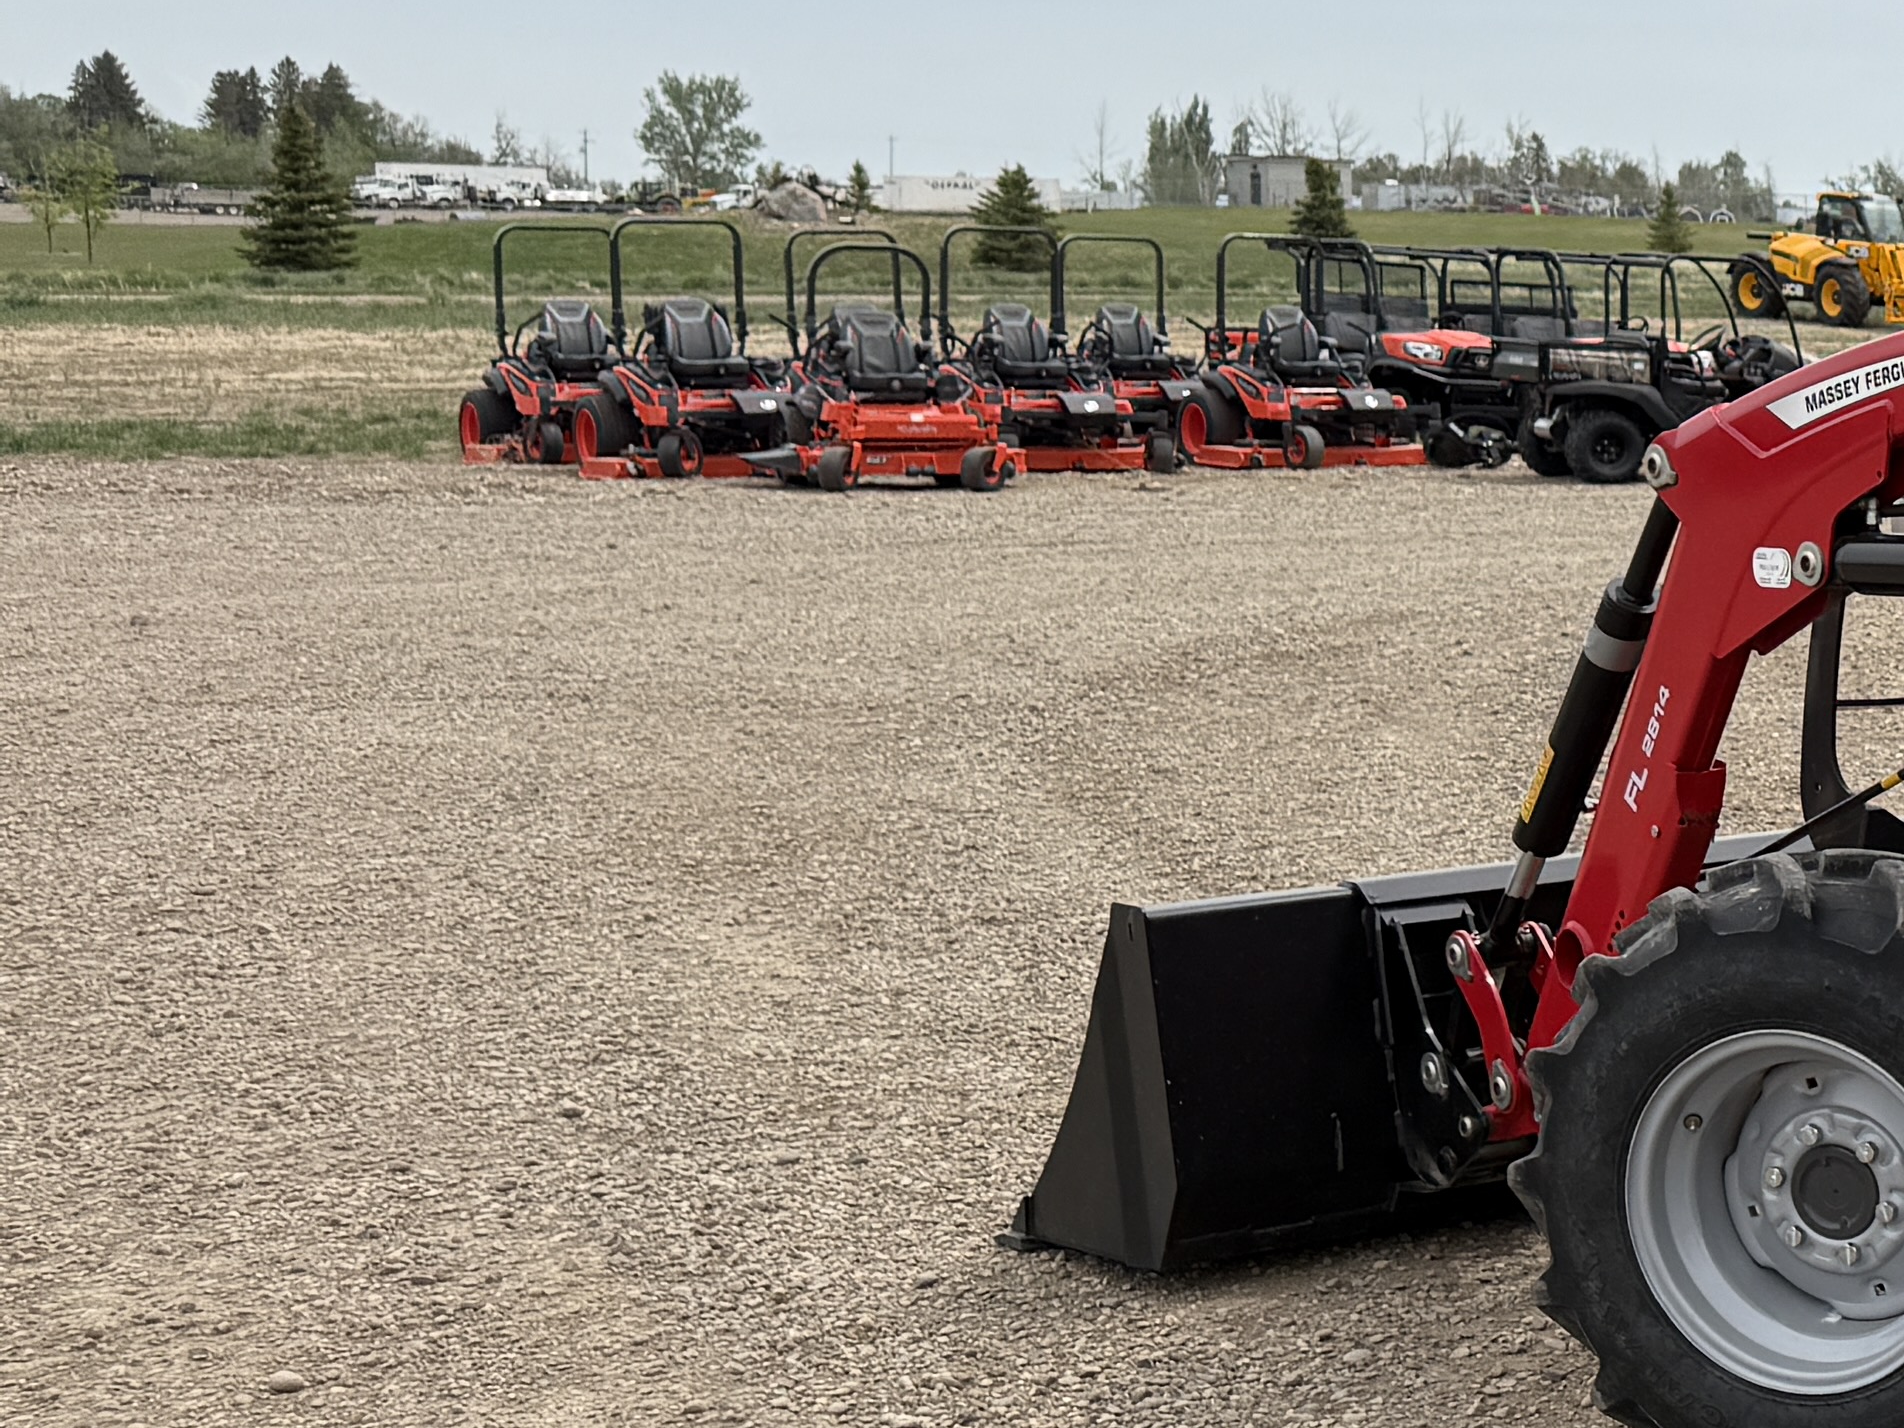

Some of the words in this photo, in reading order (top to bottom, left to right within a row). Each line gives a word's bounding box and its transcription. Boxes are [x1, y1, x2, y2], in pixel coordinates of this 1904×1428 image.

[1804, 375, 1860, 414] MASSEY
[1623, 767, 1649, 813] FL
[1641, 684, 1671, 759] 2814
